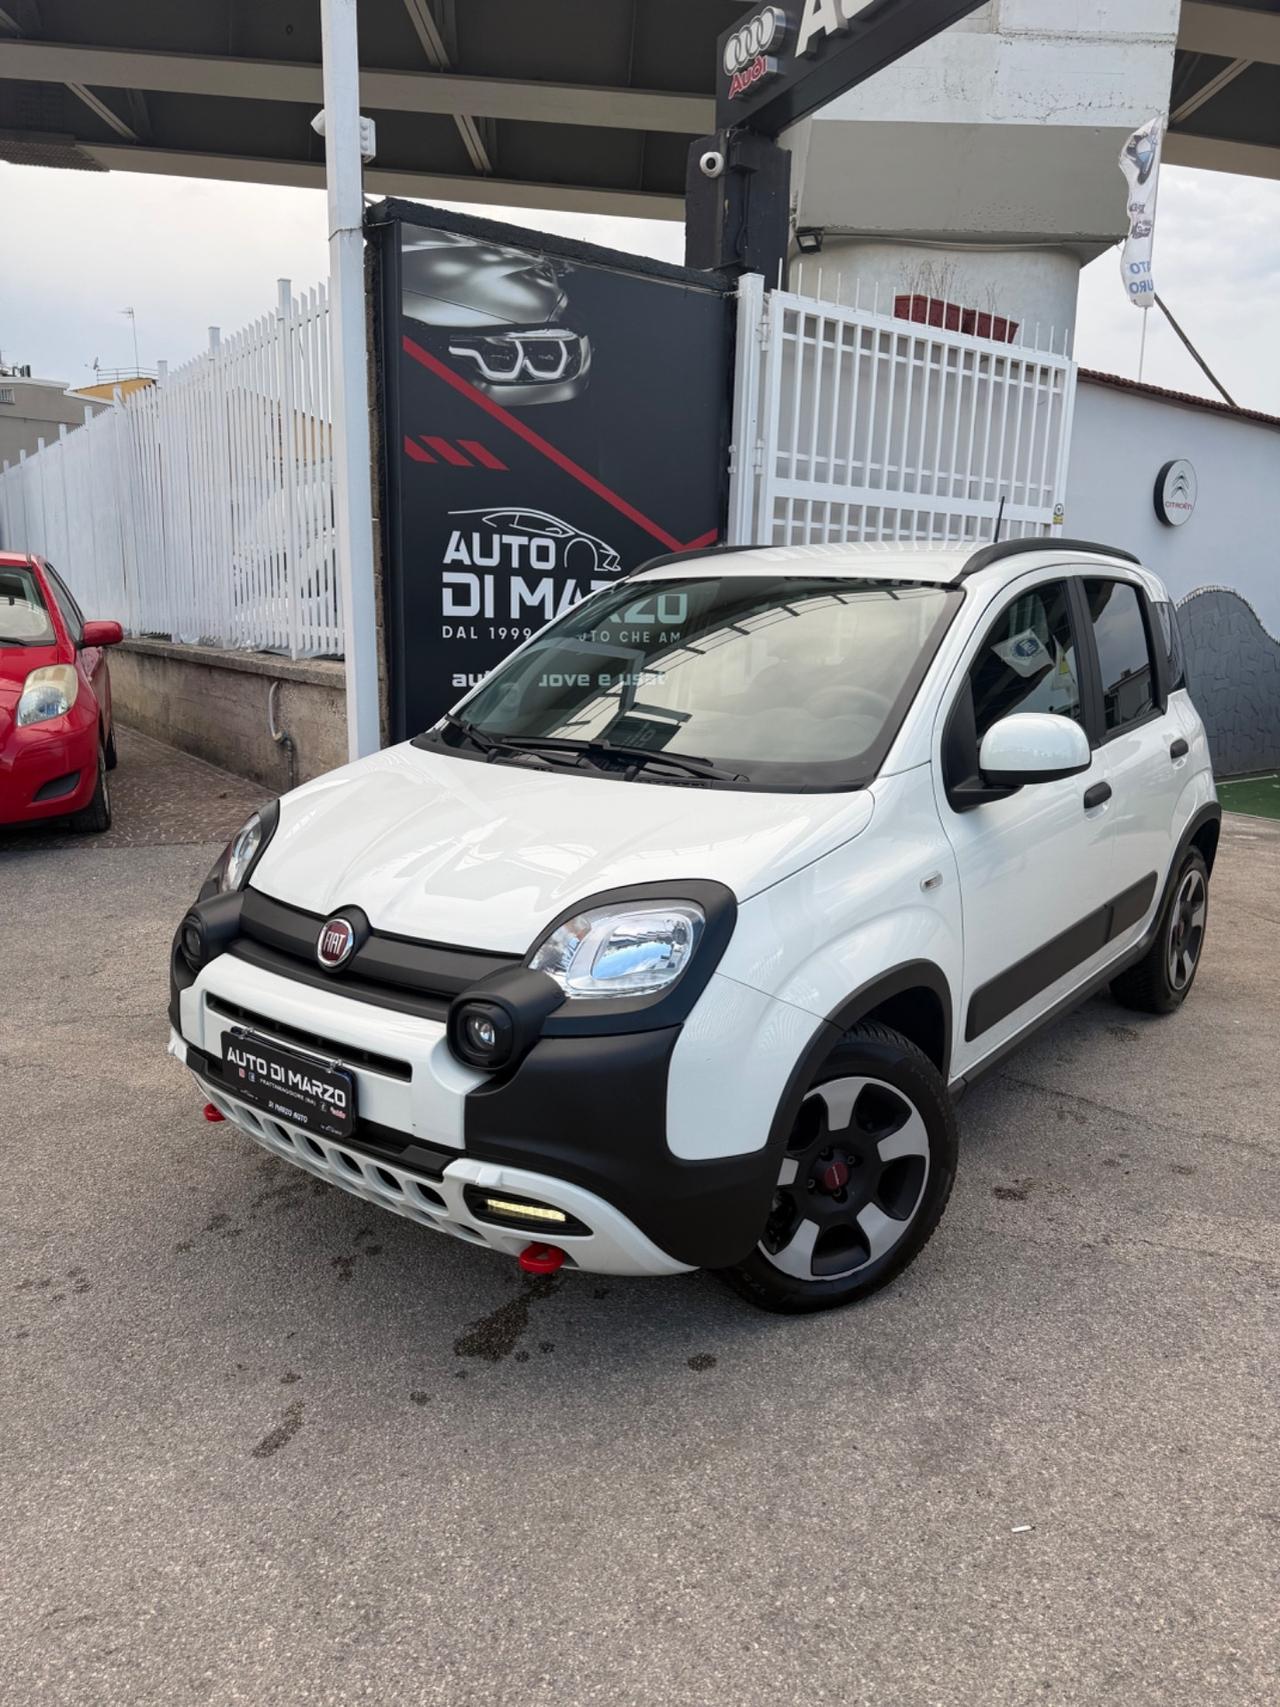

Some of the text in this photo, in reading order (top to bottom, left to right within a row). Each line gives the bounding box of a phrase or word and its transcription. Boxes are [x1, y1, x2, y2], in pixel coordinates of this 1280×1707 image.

[728, 54, 768, 100] Audi
[442, 530, 556, 570] AUTO
[442, 571, 688, 625] DI MAZO
[442, 625, 478, 640] DAL
[490, 626, 532, 641] 1999
[619, 630, 650, 643] CHE
[452, 671, 490, 688] au
[598, 674, 612, 687] e
[323, 931, 347, 955] FIAT
[227, 1046, 268, 1075] AUTO
[270, 1062, 286, 1083] DI
[288, 1069, 346, 1108] MARZO
